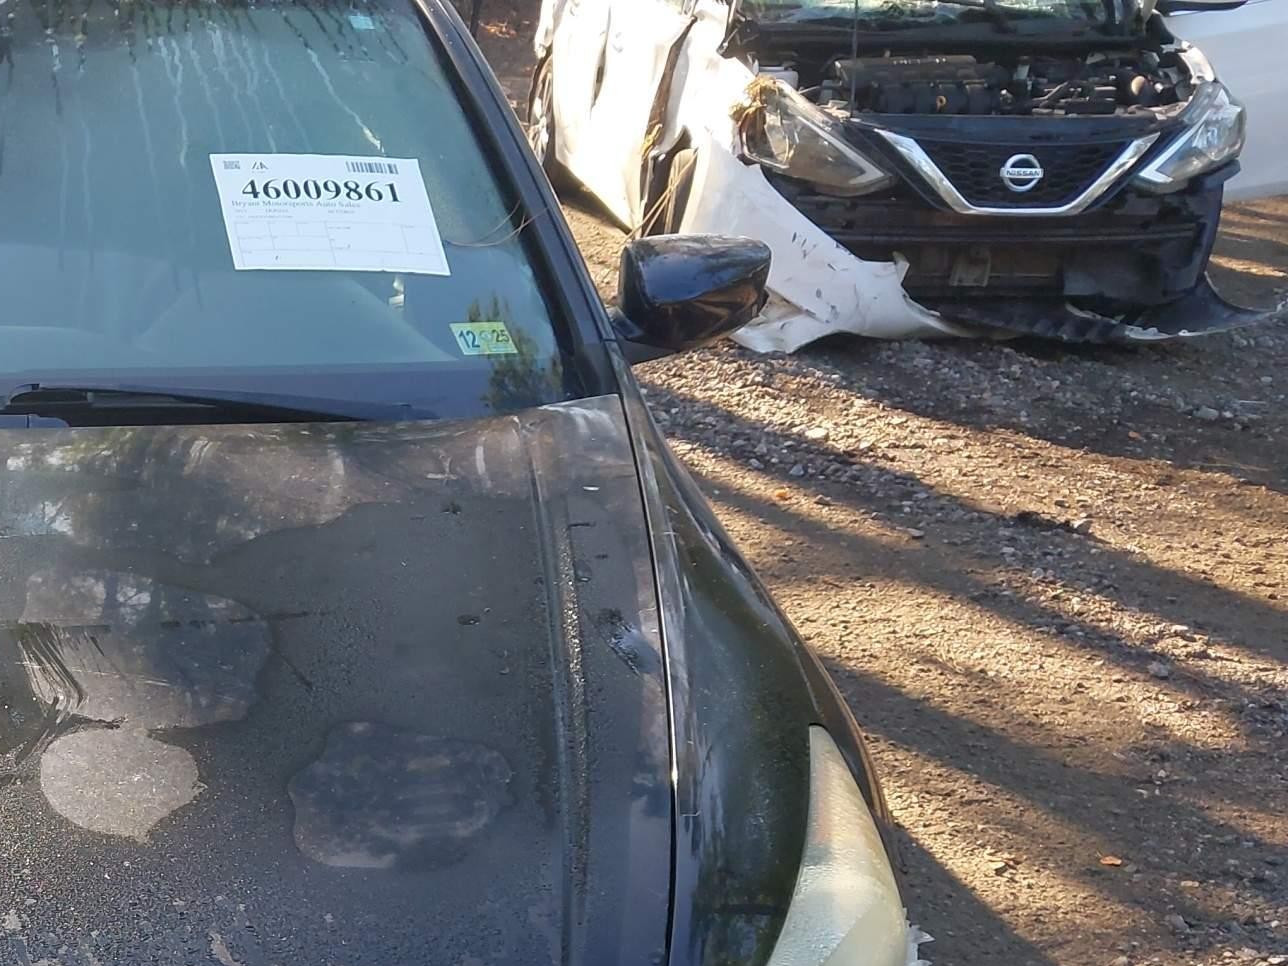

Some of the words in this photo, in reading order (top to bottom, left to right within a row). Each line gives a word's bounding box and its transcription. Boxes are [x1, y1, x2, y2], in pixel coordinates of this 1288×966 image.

[1006, 169, 1041, 177] NISSAN
[242, 178, 401, 203] 46009861
[458, 330, 481, 349] 12
[492, 329, 510, 343] 25
